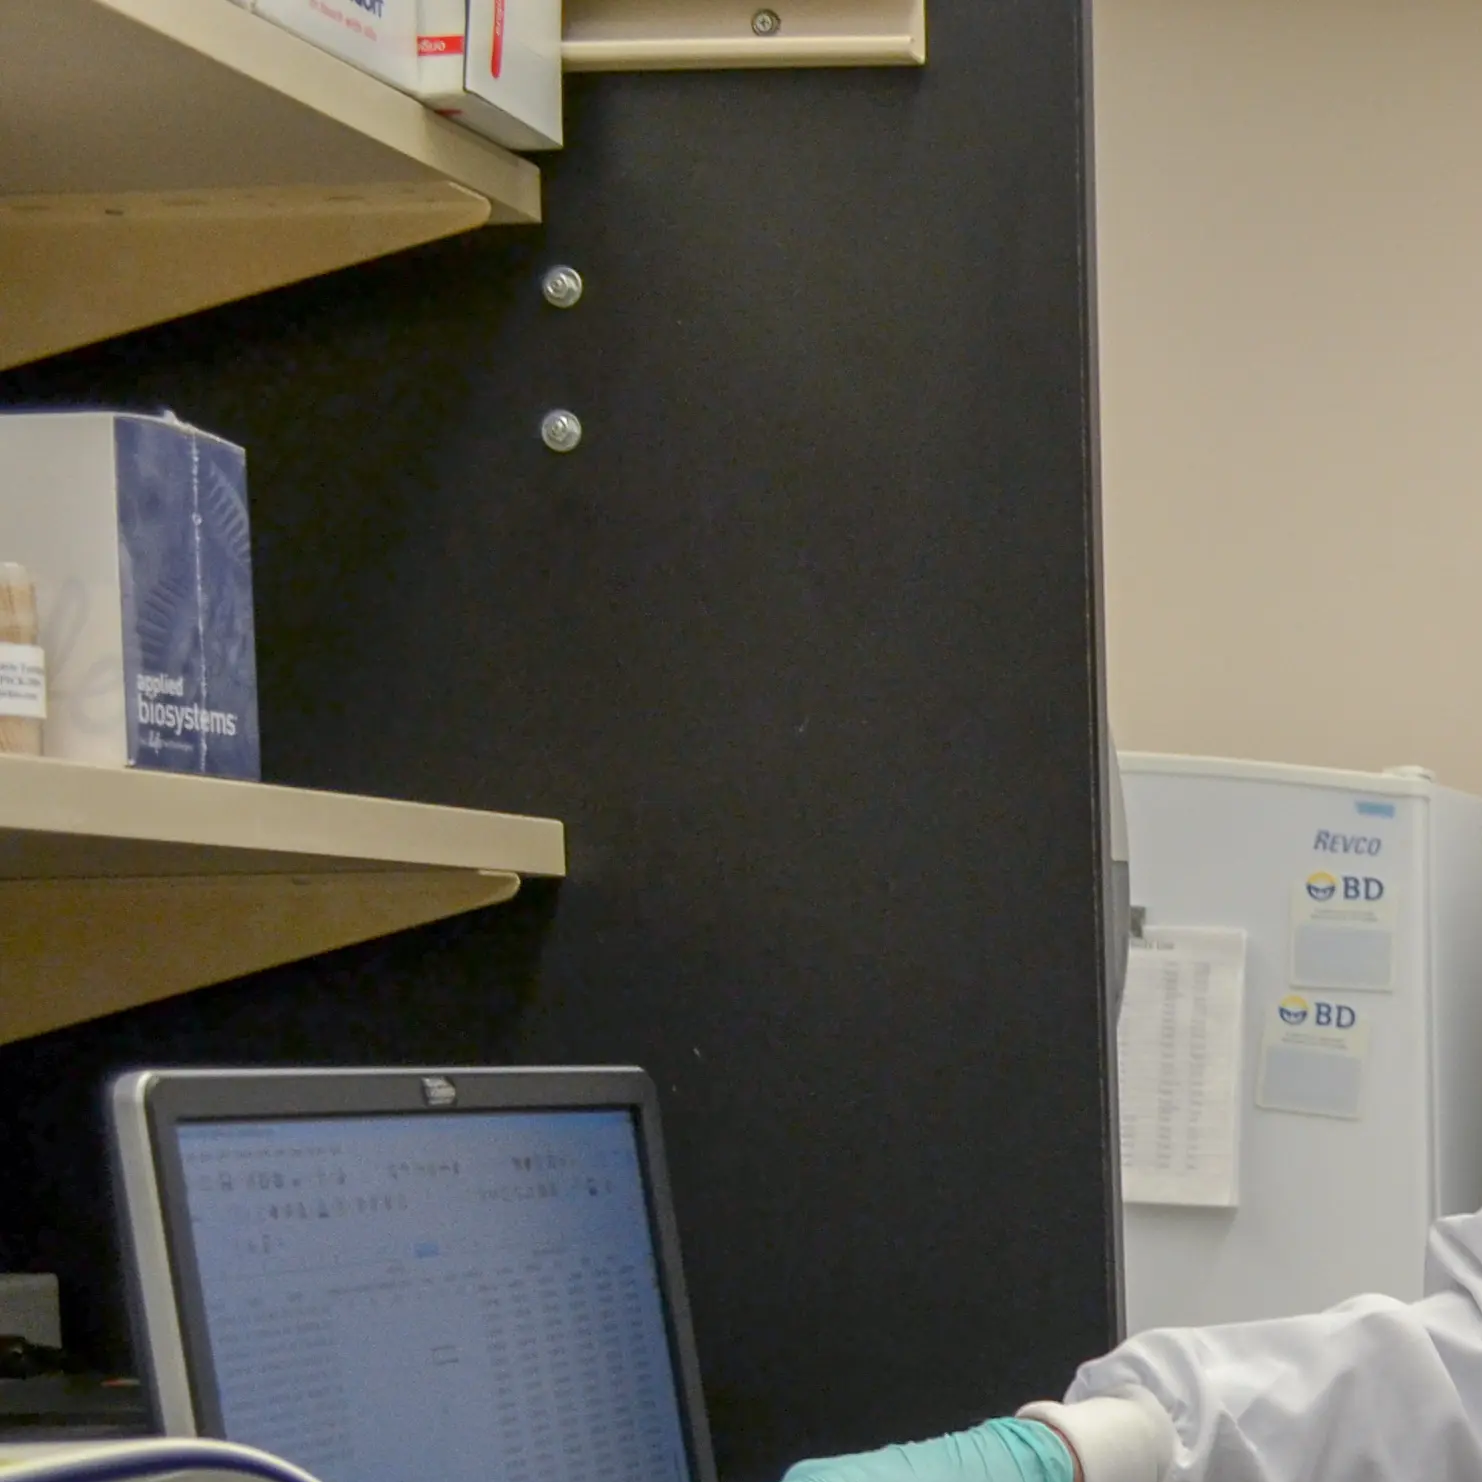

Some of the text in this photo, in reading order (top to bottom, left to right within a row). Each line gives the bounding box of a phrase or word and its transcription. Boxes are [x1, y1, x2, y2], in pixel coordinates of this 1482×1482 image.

[136, 672, 184, 698] applied
[138, 693, 237, 736] biosystems
[1313, 829, 1382, 856] REVCO
[1342, 876, 1384, 901] BD
[1315, 1002, 1357, 1029] BD
